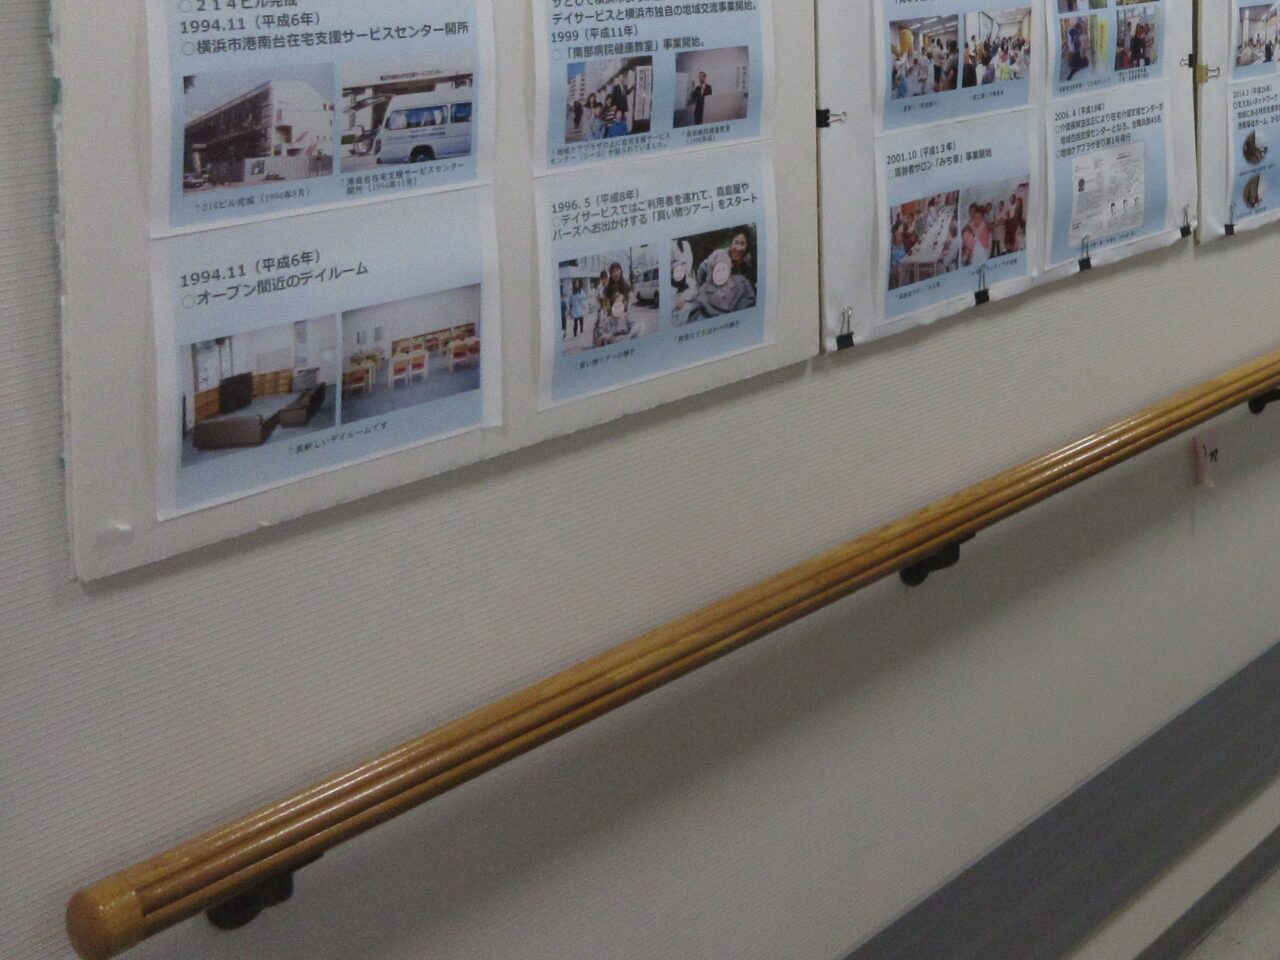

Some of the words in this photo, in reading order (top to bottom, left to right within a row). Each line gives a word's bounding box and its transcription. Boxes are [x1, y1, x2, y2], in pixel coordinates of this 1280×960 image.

[179, 10, 321, 34] 1994.11（平成6年）
[552, 0, 756, 25] デイサービスと横浜市独自の地域交流事業開始。
[196, 20, 469, 54] 横浜市港南台在宅支援サービスセンター開所
[550, 24, 638, 43] 1999（平成11年）
[563, 35, 705, 60] 「南部病院健康教室」事業開始。
[551, 192, 758, 242] バーズへお出かけする「買い物ツアー」をスタート
[560, 181, 749, 226] デイサービスではご利用者を連れて、高島屋や
[179, 248, 320, 288] 1994.11（平成6年）
[196, 259, 368, 307] オープン間近のデイルーム
